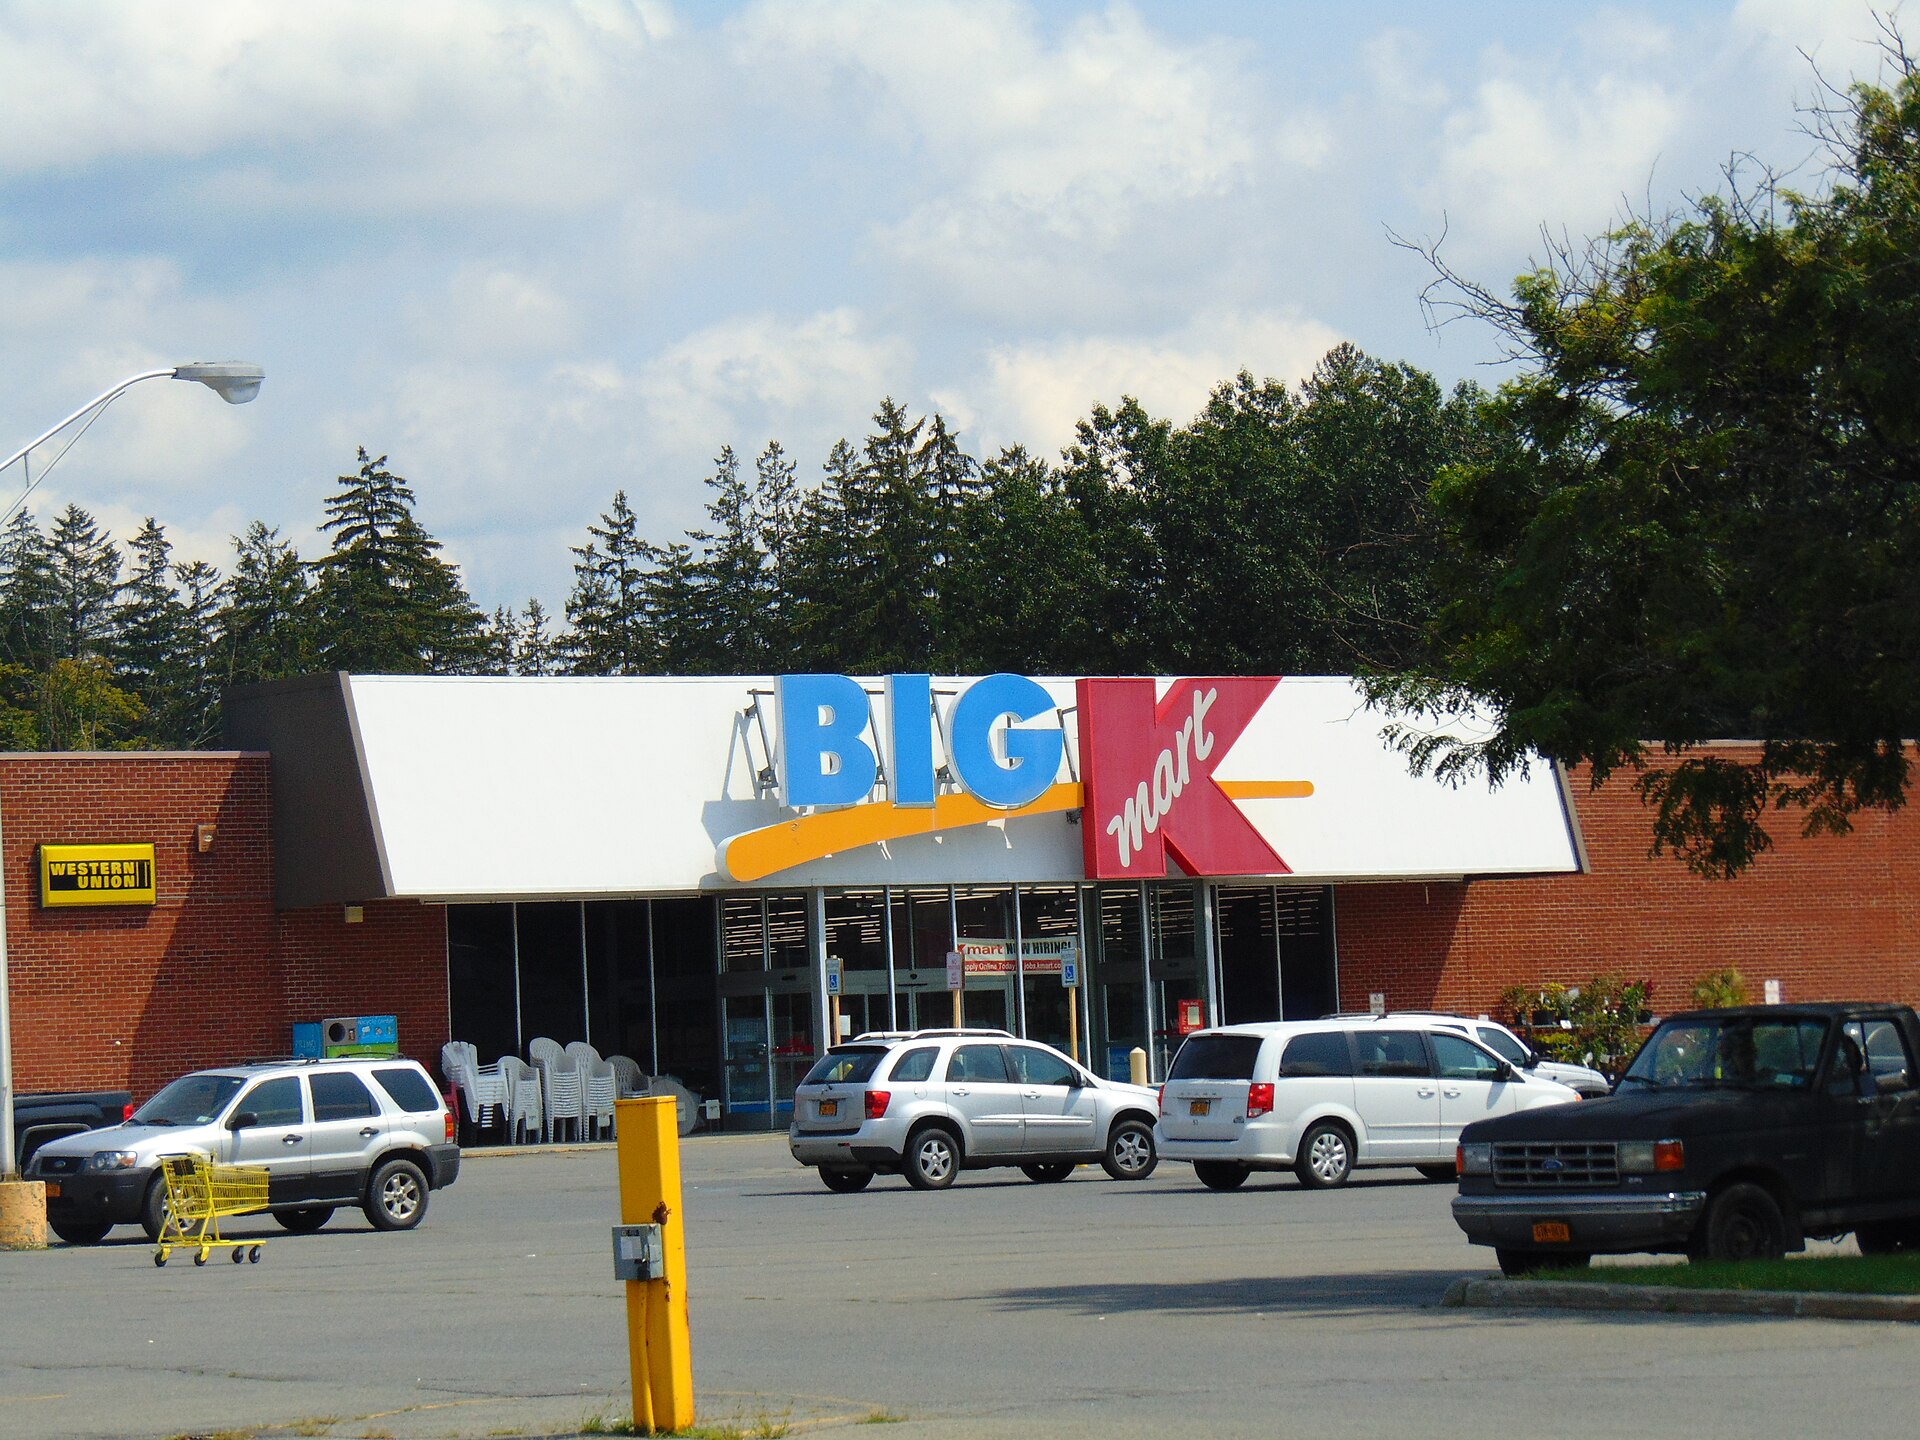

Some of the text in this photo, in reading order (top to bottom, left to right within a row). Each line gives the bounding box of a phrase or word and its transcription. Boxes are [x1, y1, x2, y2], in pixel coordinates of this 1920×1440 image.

[774, 673, 1293, 880] BIG K
[1107, 687, 1217, 868] mart
[50, 862, 135, 876] WESTERN
[78, 875, 135, 889] UNION
[1023, 962, 1062, 972] jobs.kmart.co
